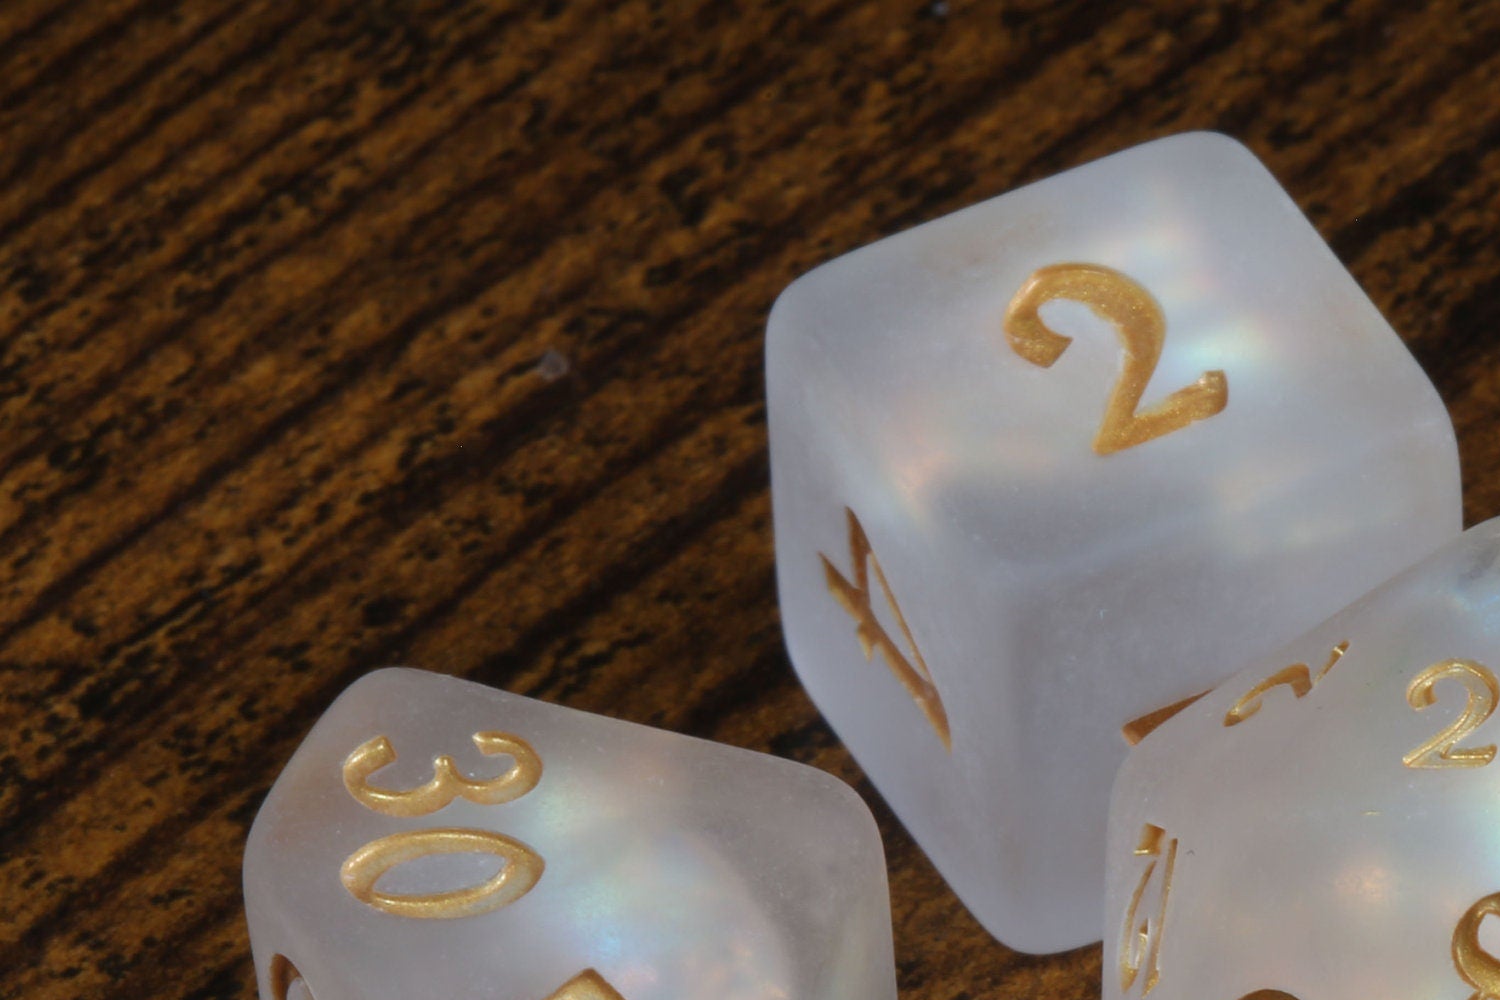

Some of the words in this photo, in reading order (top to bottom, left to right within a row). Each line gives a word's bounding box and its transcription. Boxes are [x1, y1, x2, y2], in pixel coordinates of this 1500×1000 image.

[1004, 261, 1229, 457] 2
[817, 505, 953, 754] 4
[339, 730, 546, 920] 30
